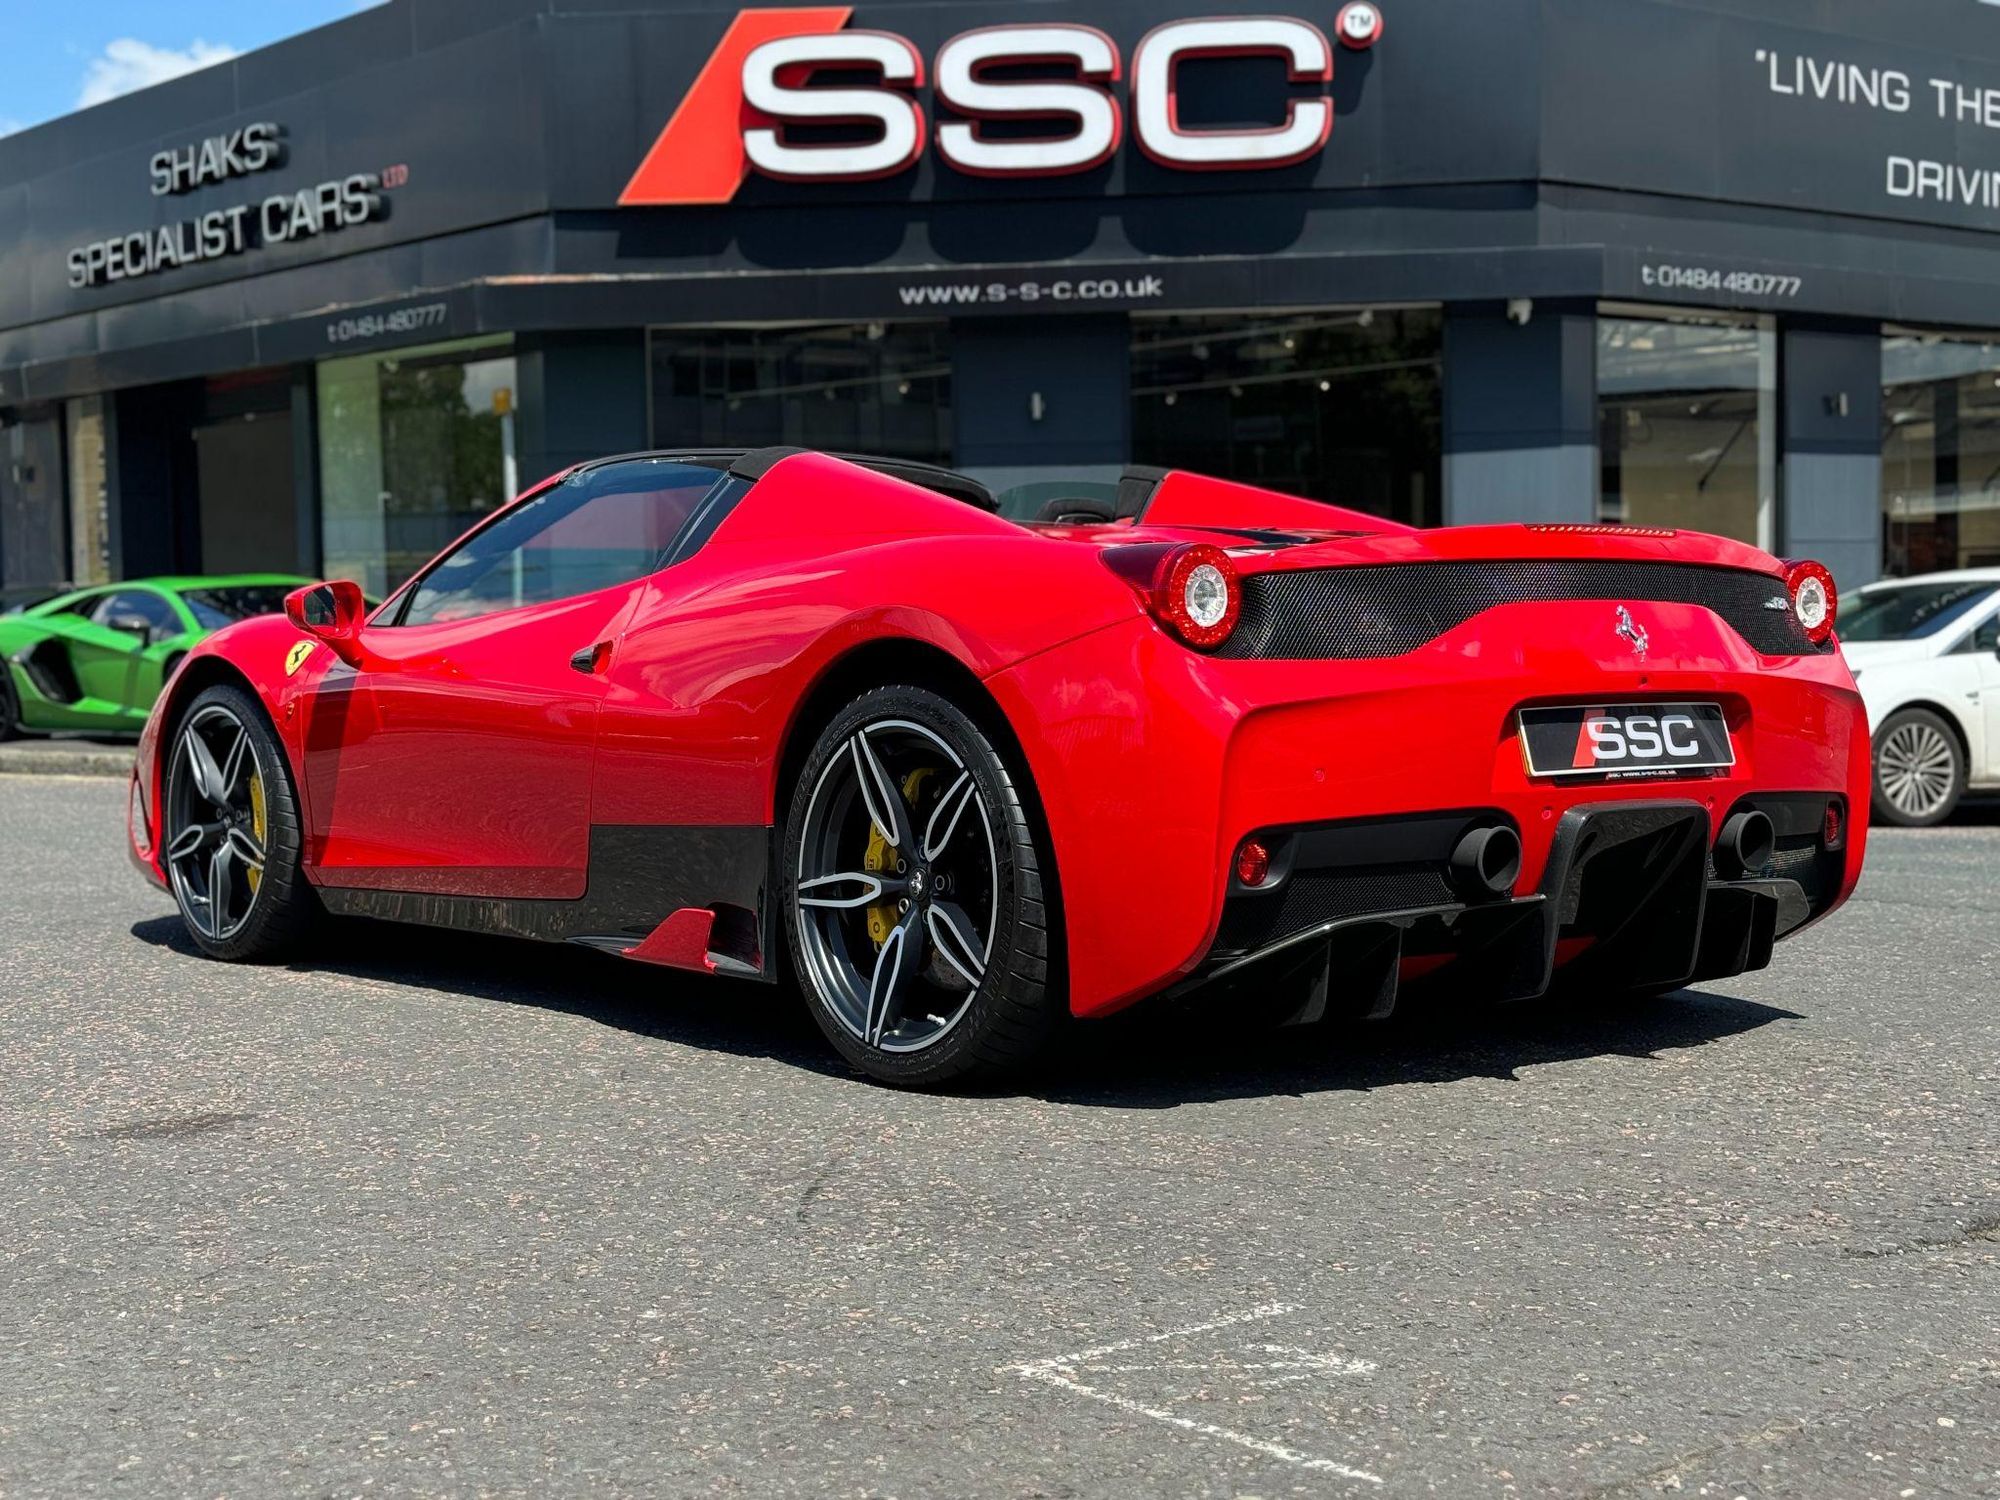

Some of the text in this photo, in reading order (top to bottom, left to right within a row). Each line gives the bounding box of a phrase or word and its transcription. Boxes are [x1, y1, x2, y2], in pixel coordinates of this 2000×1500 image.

[741, 16, 1333, 182] SSC
[1929, 78, 2000, 129] THE
[149, 121, 274, 196] SHAKS
[1886, 155, 2000, 209] DRIVI
[66, 163, 409, 289] SPECIALIST CARS LTD
[899, 275, 1164, 305] www.s-s-c.co.uk
[1586, 714, 1699, 760] SSC
